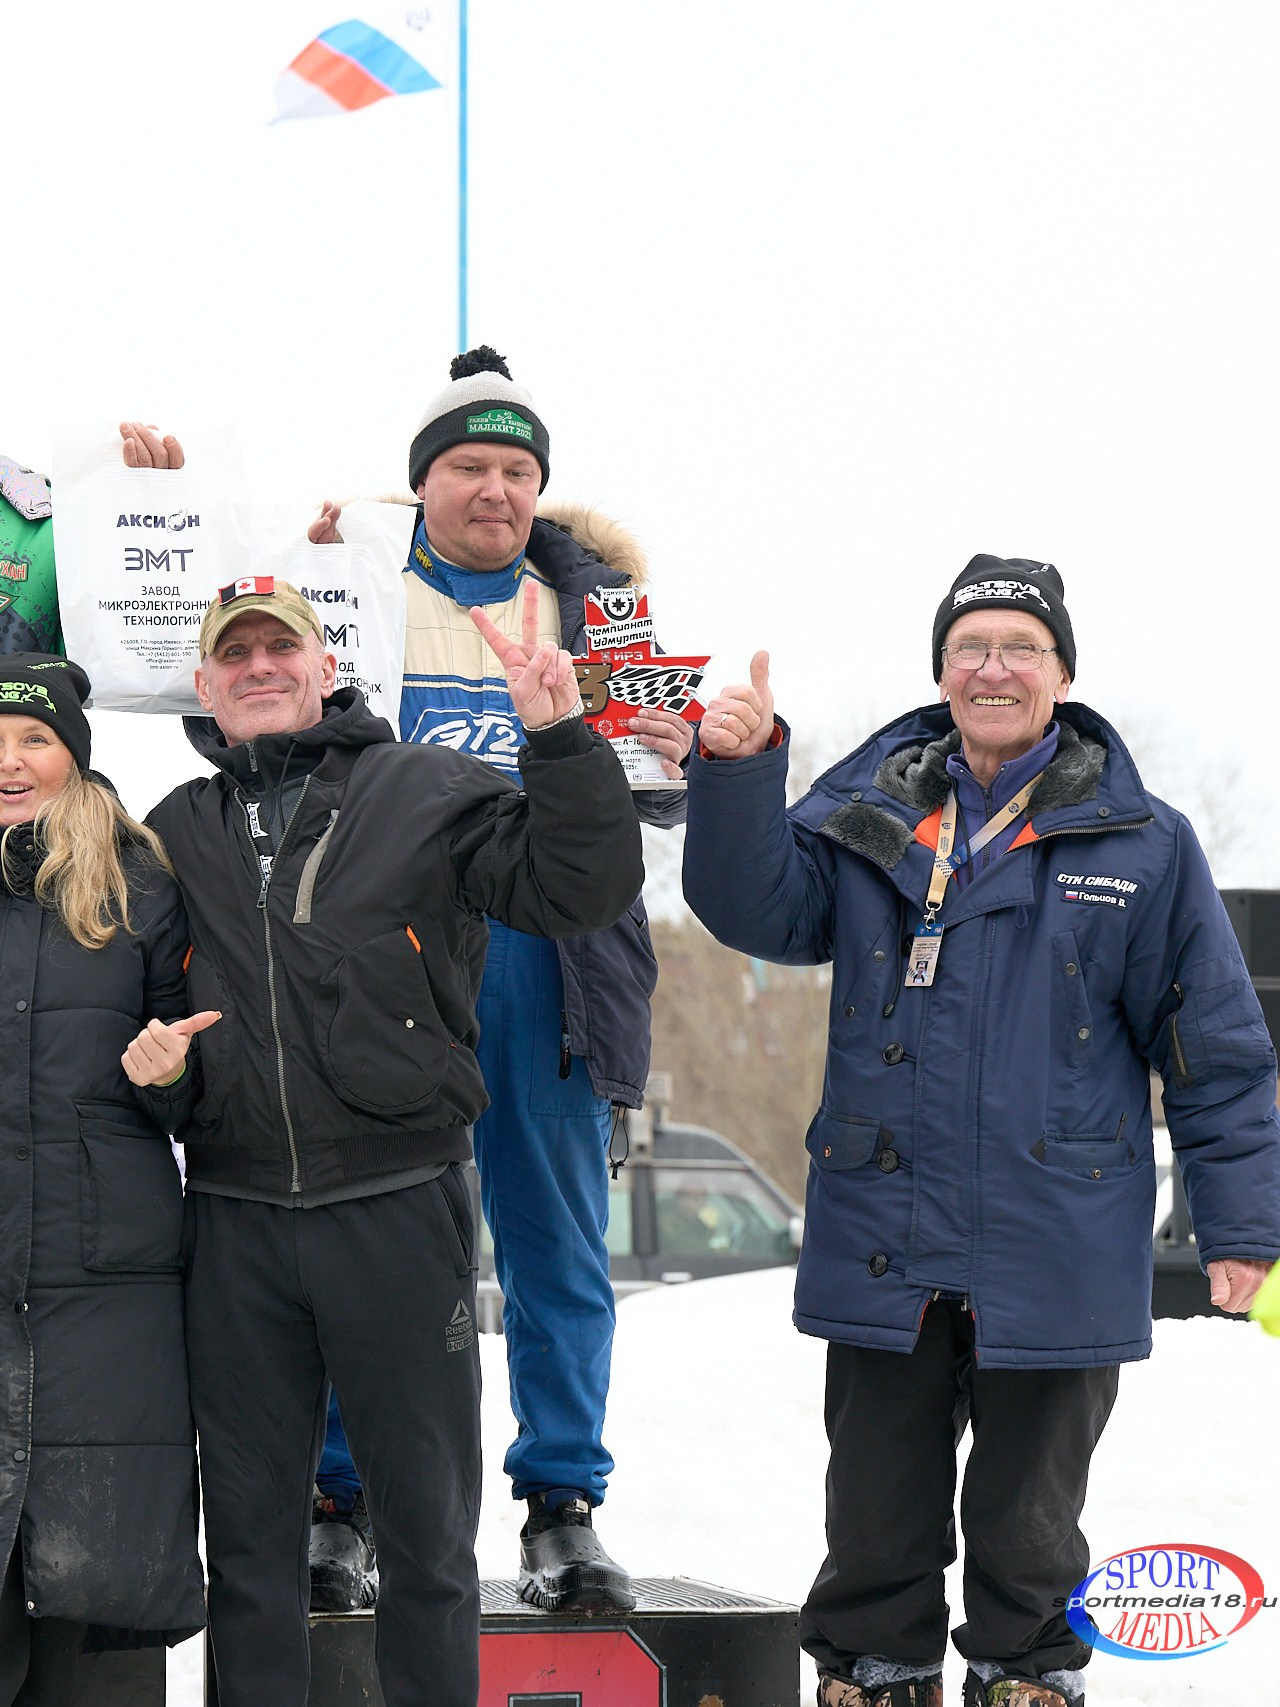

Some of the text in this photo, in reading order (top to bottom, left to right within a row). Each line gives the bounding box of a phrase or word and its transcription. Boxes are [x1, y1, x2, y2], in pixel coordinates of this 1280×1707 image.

[469, 424, 515, 433] МАЛАХИТ
[116, 509, 200, 532] АКСИОН
[124, 547, 193, 572] ЗМТ
[141, 586, 180, 597] ЗАВОД
[301, 586, 359, 610] АКСИН
[98, 600, 209, 611] МИКРОЭЛЕКТРОНН
[123, 613, 201, 626] ТЕХНОЛОГИЙ
[573, 663, 612, 716] 3
[420, 715, 520, 753] GT2
[1056, 873, 1138, 893] СТК СИБАДИ
[1078, 892, 1126, 908] Гольцов В.
